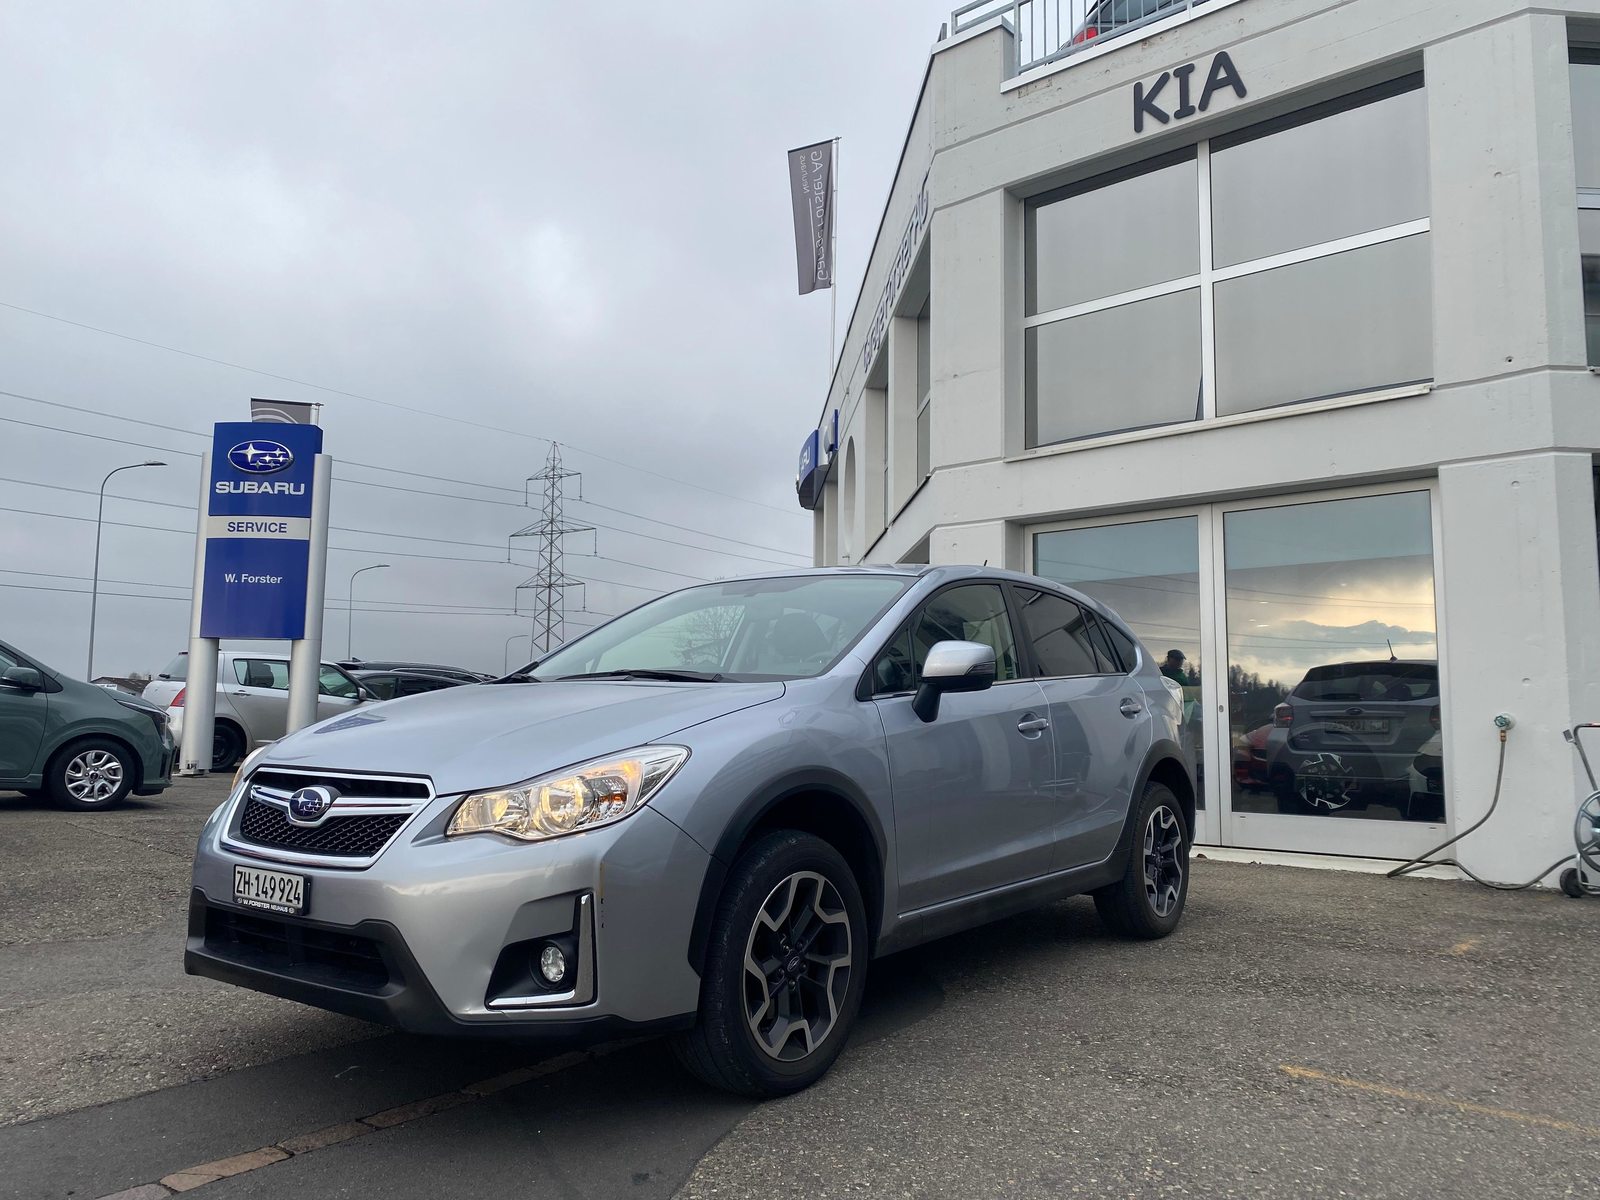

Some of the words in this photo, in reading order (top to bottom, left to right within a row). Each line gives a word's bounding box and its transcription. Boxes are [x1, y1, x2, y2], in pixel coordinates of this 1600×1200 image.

[1134, 51, 1247, 133] KIA
[215, 481, 305, 495] SUBARU
[227, 522, 288, 533] SERVICE
[225, 573, 238, 583] W.
[241, 573, 282, 584] Forster
